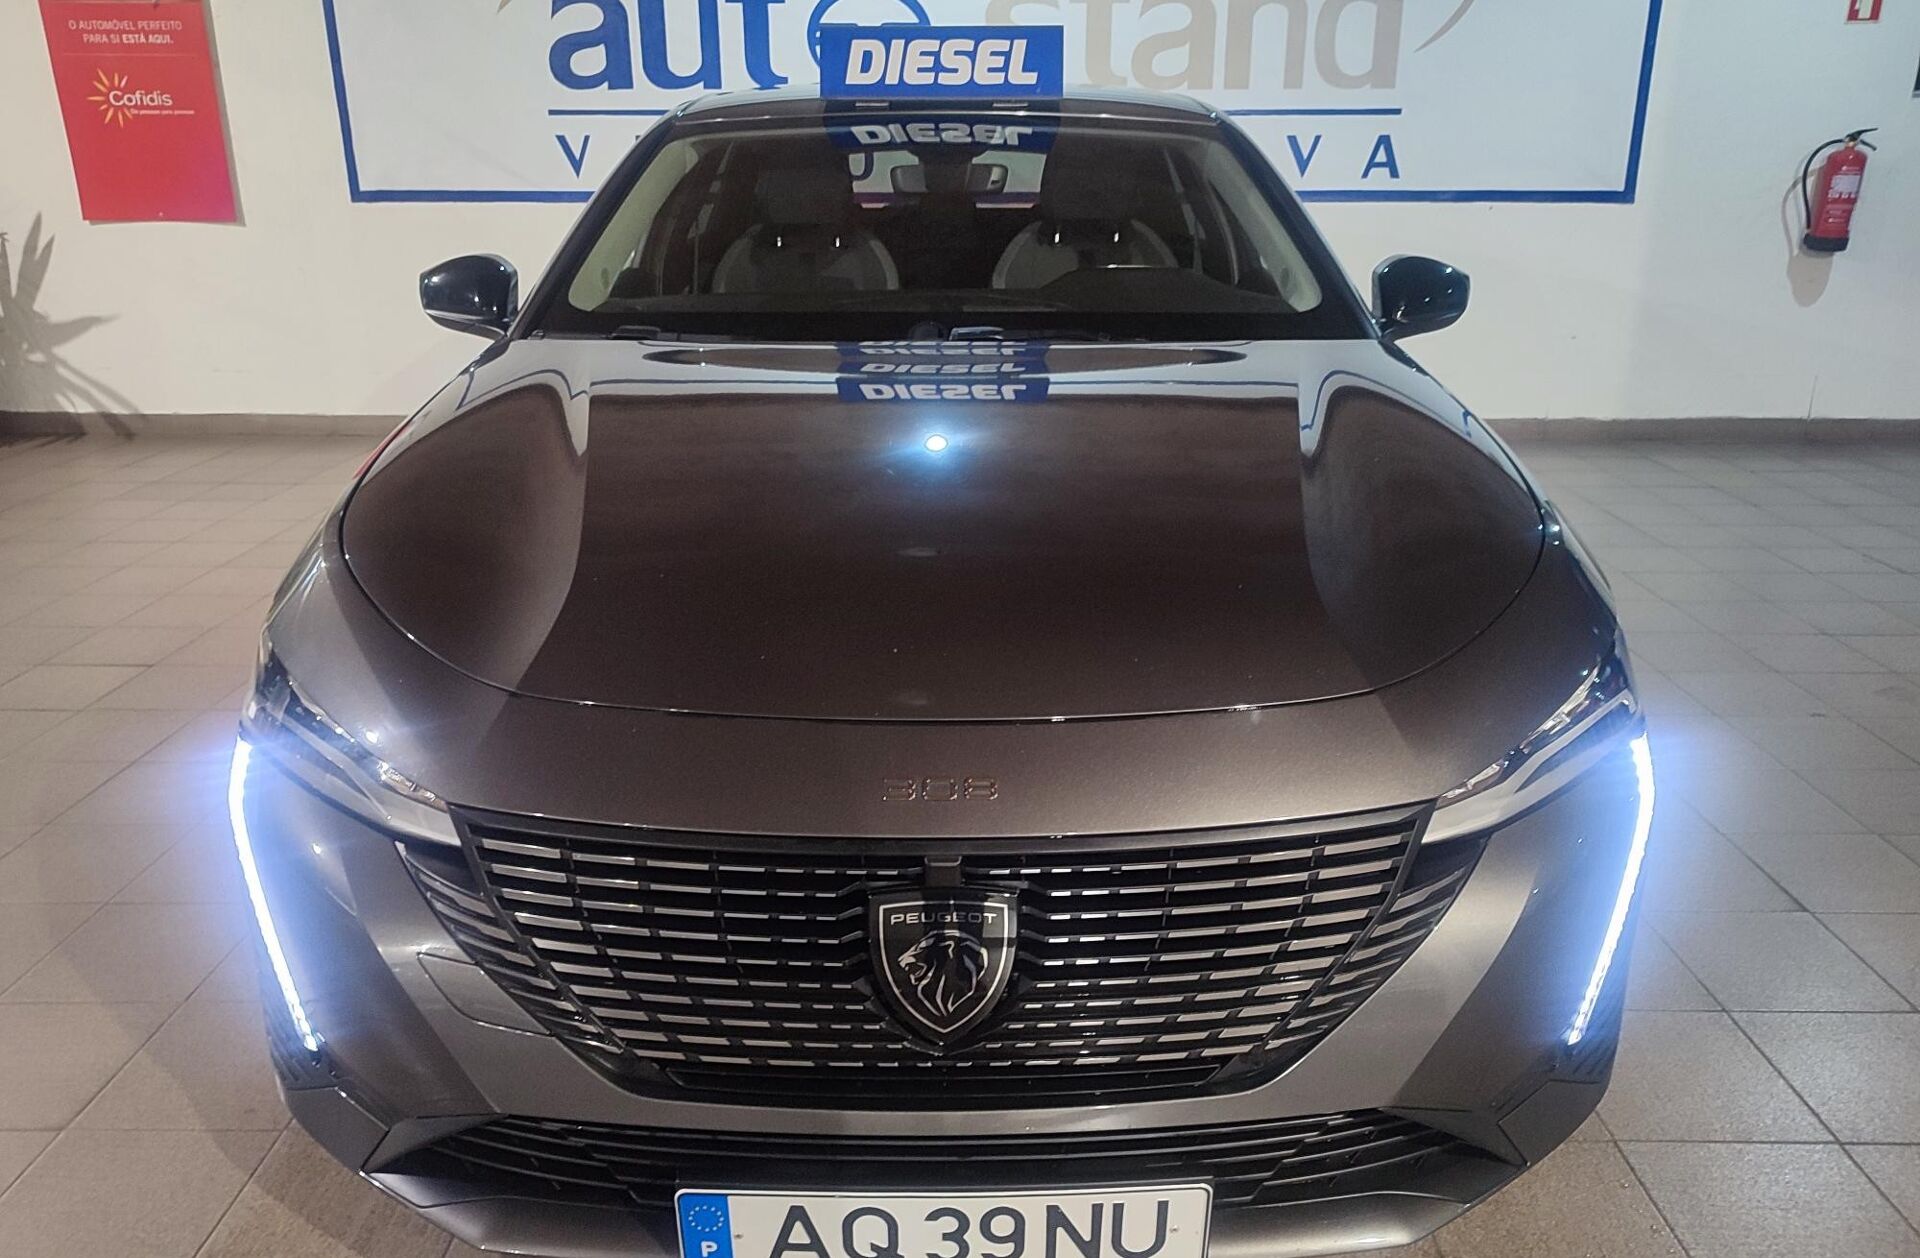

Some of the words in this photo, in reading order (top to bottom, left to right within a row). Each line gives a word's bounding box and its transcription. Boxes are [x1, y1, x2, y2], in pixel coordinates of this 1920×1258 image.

[68, 20, 77, 30] O
[79, 19, 136, 30] AUTOMÓVEL
[138, 21, 182, 31] PERFEITO
[83, 34, 109, 44] PARA
[110, 34, 120, 44] SI
[122, 33, 147, 44] ESTÁ
[845, 39, 1038, 85] DIESEL
[108, 90, 173, 106] Cofidis
[882, 777, 999, 801] 308
[890, 912, 998, 925] PEUGEOT
[701, 1241, 718, 1257] P
